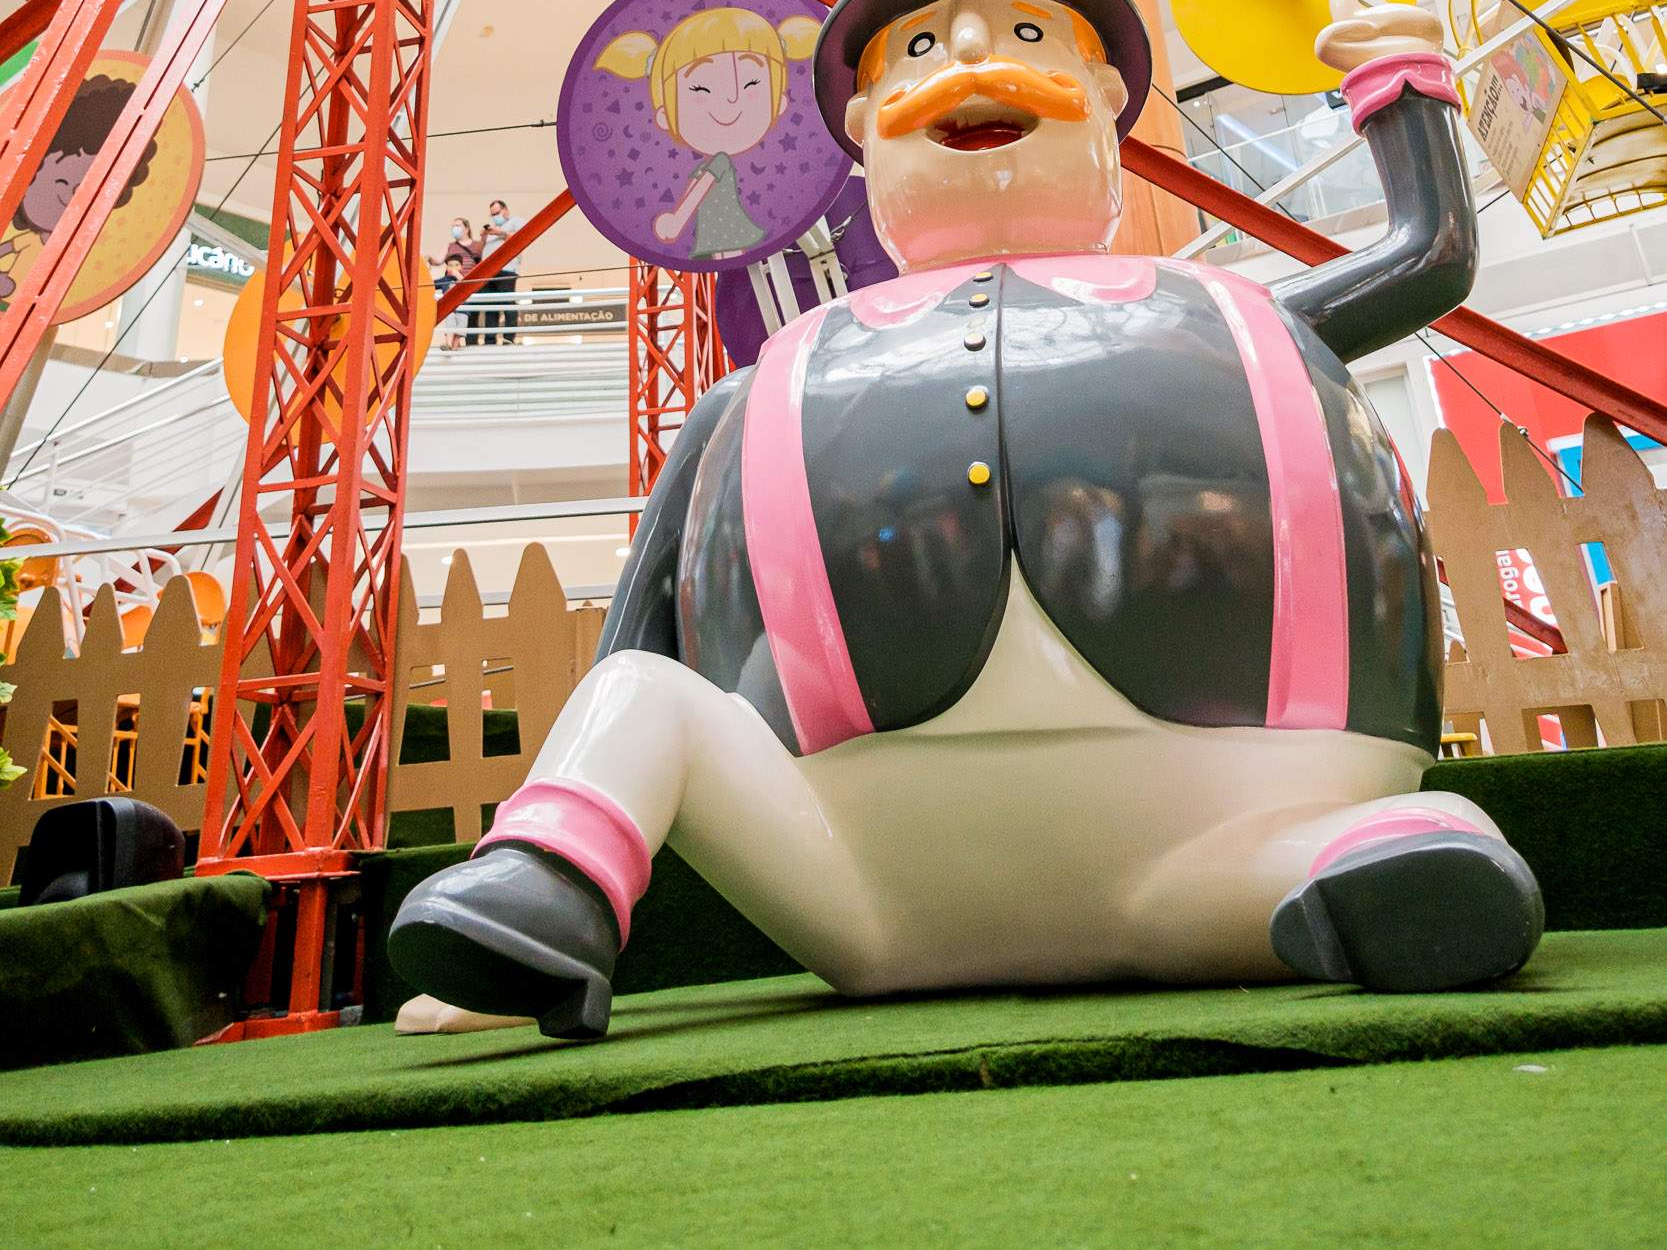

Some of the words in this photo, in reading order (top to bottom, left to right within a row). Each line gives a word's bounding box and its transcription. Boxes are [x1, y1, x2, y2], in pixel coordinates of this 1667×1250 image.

[1476, 74, 1504, 143] ATENÇÃO!!!
[524, 313, 539, 323] DE
[540, 310, 614, 323] ALIMENTAÇÃO
